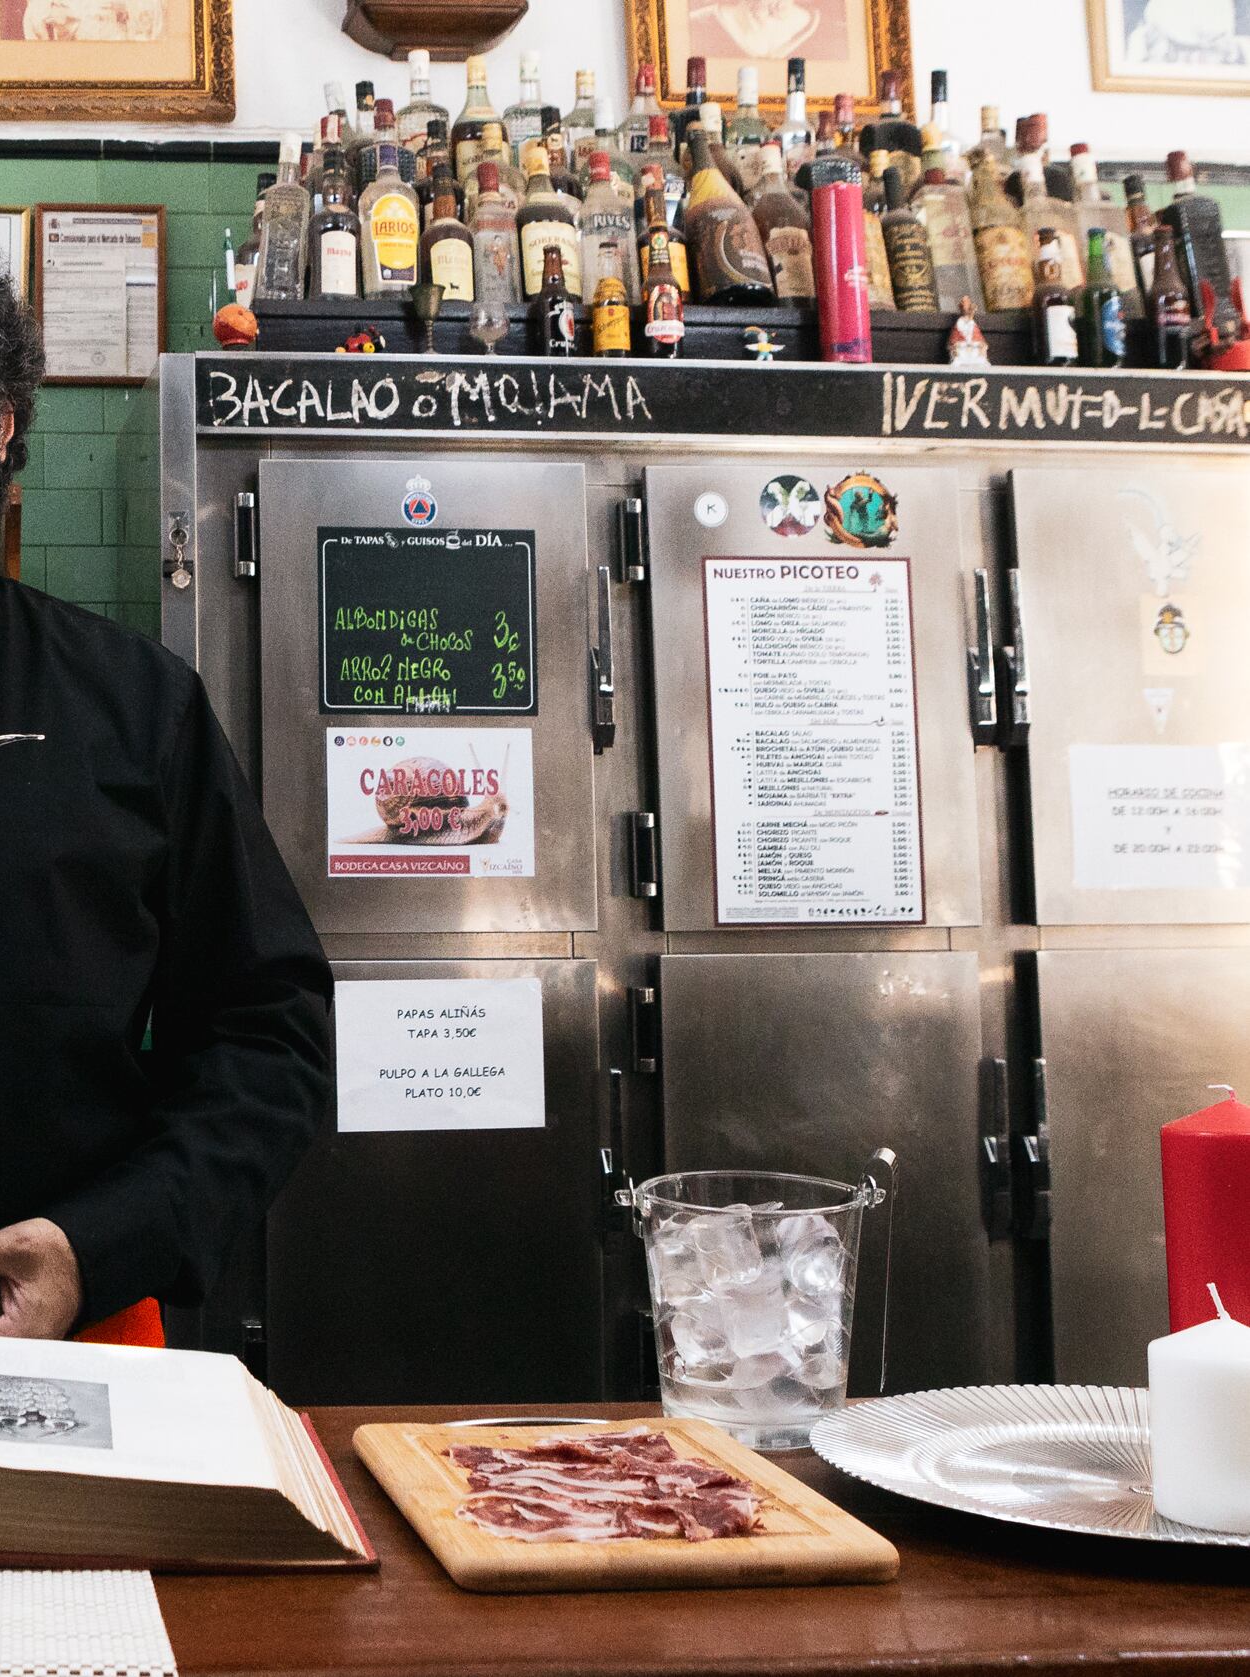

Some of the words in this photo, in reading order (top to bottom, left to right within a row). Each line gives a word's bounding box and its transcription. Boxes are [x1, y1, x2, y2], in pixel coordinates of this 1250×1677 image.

[375, 220, 416, 236] LARIOS
[594, 214, 630, 230] RIVES
[209, 371, 400, 426] BACALAO
[354, 536, 384, 544] TAPAS
[407, 537, 445, 545] GUISOS
[475, 532, 502, 546] DÍA
[714, 568, 775, 579] NUESTRO
[780, 566, 859, 579] PICOTEO
[416, 629, 473, 651] CHOCOS
[397, 657, 451, 681] NEGRO
[354, 686, 385, 704] CON
[360, 768, 499, 796] CARACOLES
[335, 862, 378, 871] BODEGA
[380, 862, 408, 871] CASA
[410, 860, 464, 871] VIZCAÍNO
[398, 1009, 434, 1019] PAPAS
[440, 1006, 486, 1019] ALIÑÁS
[407, 1030, 438, 1038] TAPA
[444, 1028, 477, 1039] 3,50€
[379, 1069, 416, 1079] PULPO
[421, 1069, 429, 1078] A
[435, 1069, 448, 1077] LA
[454, 1067, 505, 1077] GALLEGA
[405, 1088, 443, 1098] PLATO
[449, 1087, 481, 1098] 10,0€
